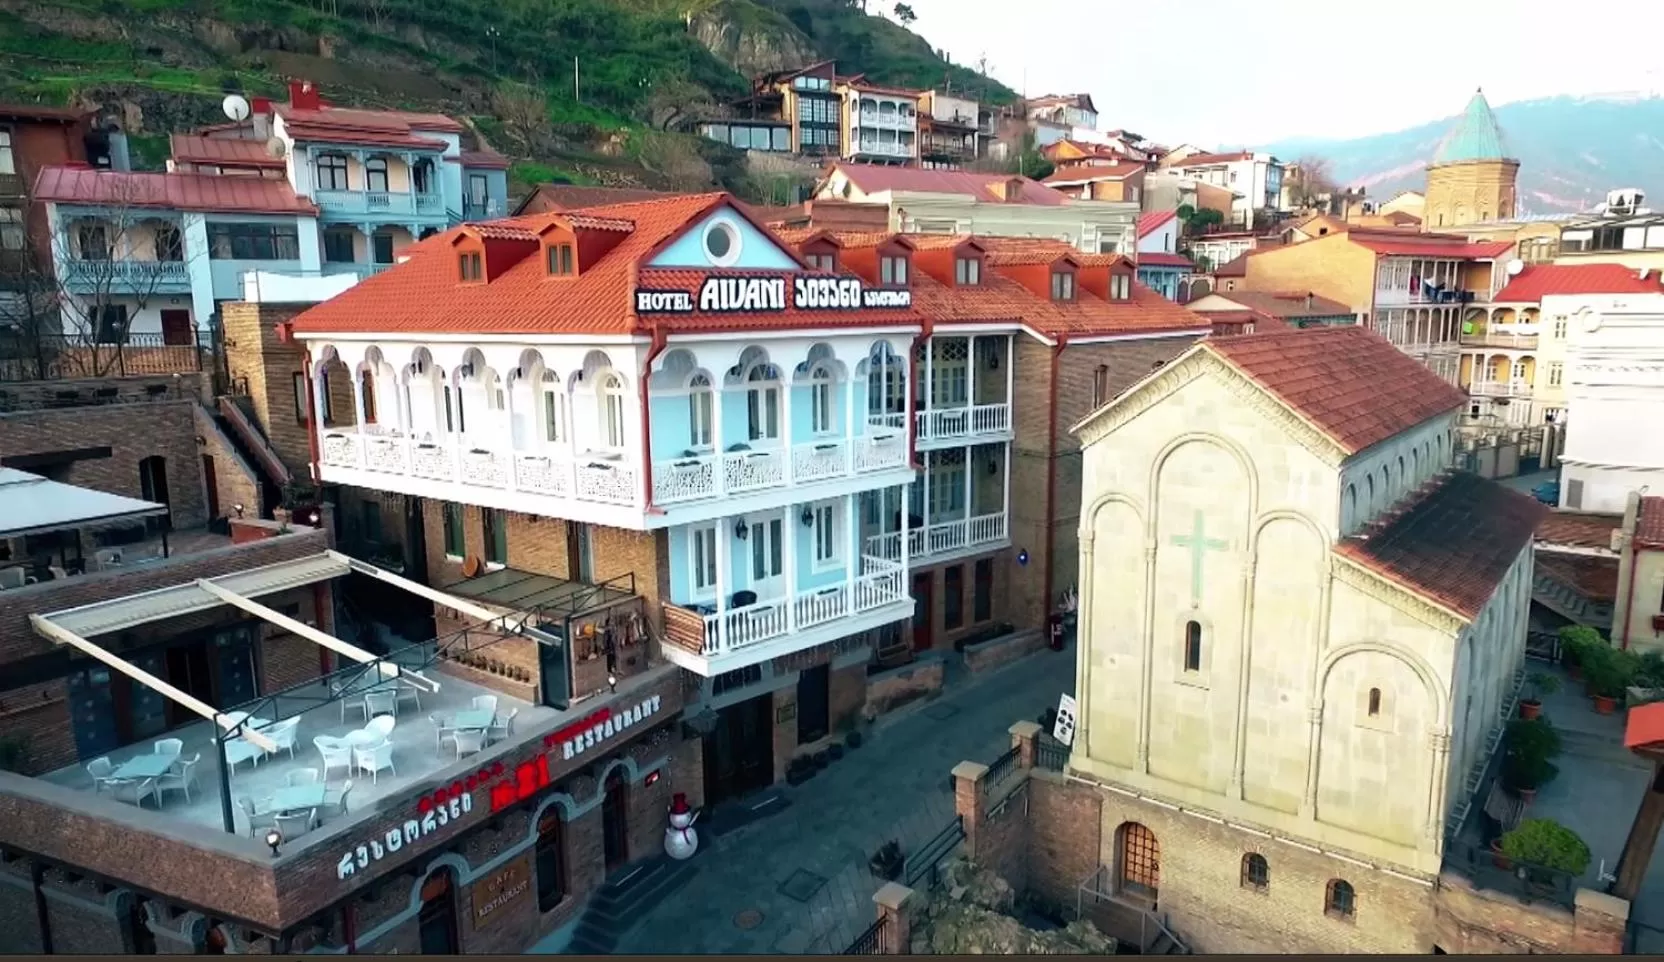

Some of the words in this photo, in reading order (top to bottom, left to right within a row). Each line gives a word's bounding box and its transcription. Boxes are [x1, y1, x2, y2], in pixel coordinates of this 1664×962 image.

[637, 292, 693, 311] HOTEL
[700, 278, 786, 310] AIVANI
[795, 278, 861, 308] აივანი
[562, 695, 661, 760] RESTAURANT
[337, 792, 473, 880] რესტორანი
